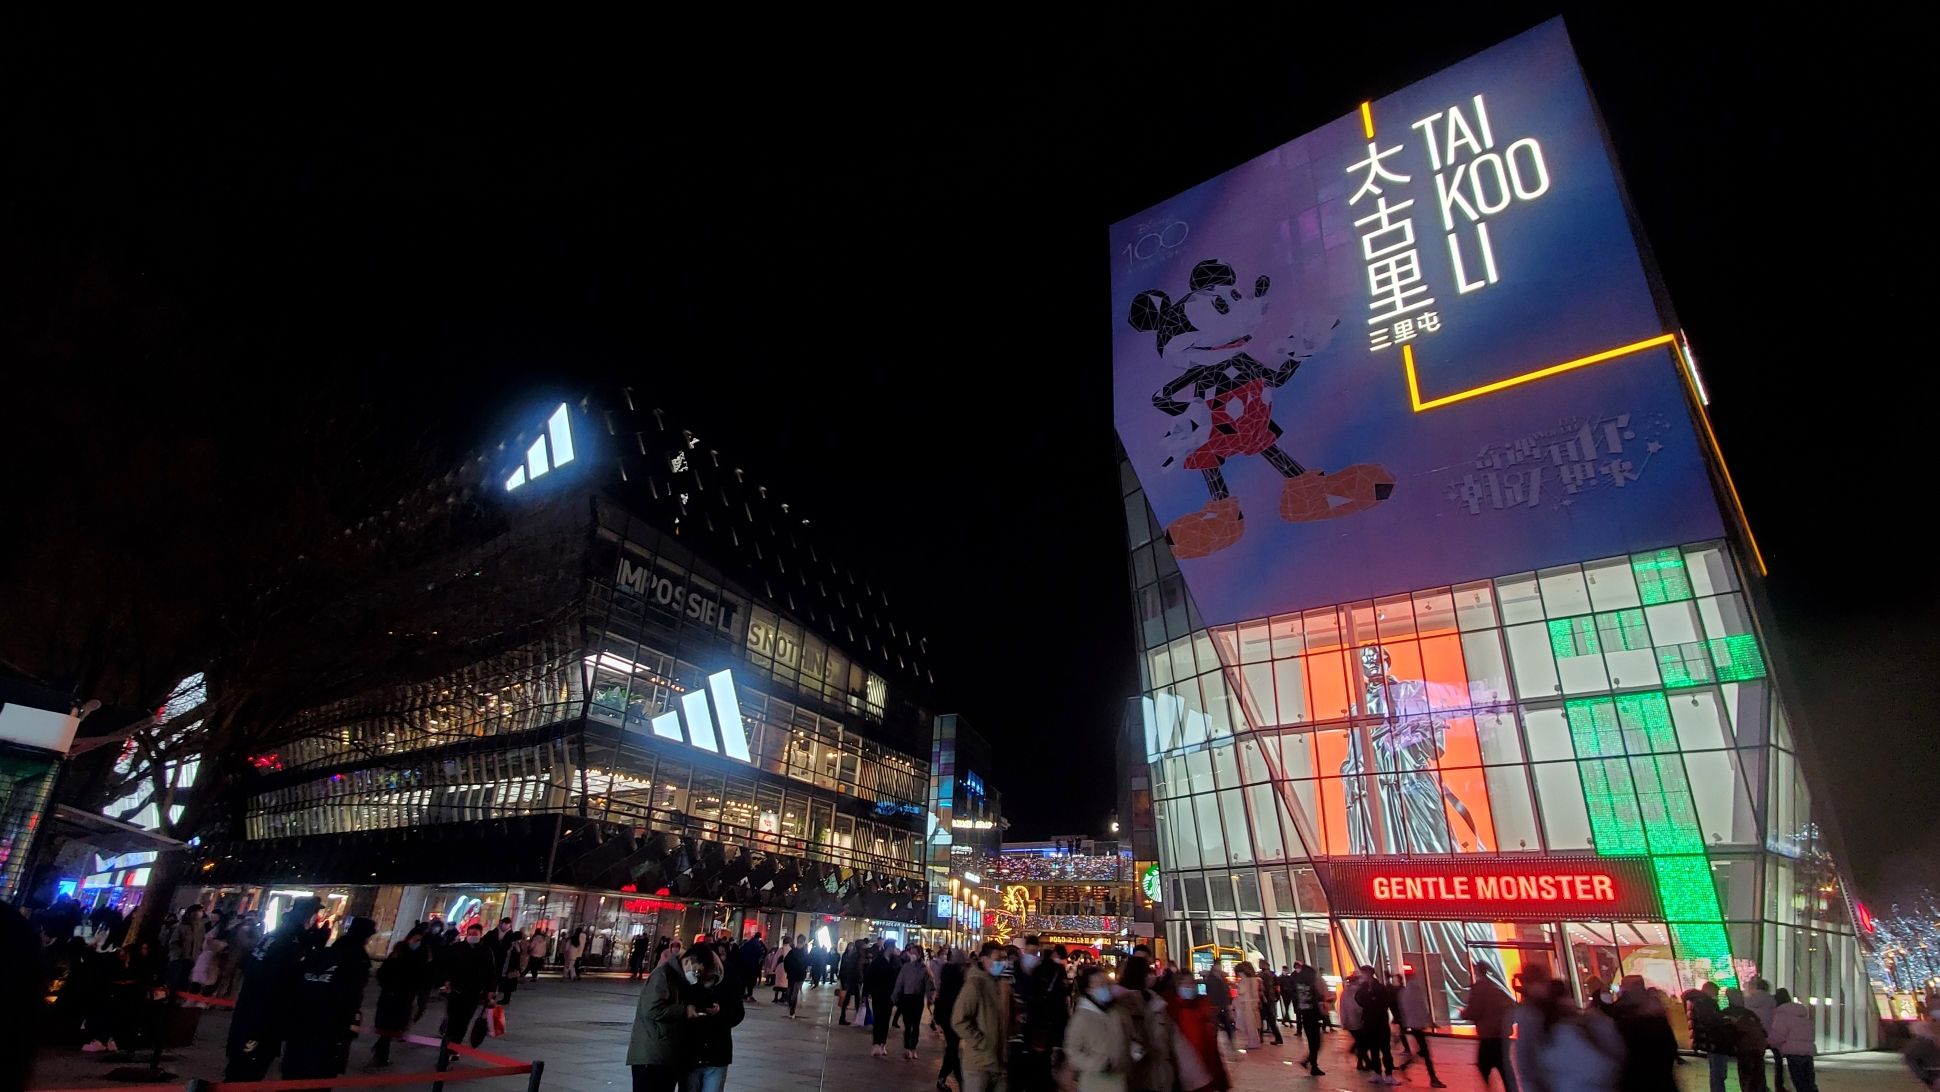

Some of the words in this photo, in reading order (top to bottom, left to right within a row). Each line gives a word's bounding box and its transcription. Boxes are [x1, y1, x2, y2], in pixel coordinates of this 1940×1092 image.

[1411, 94, 1494, 170] TAI
[1435, 137, 1549, 231] KOO
[1121, 221, 1189, 265] 100
[1346, 142, 1435, 325] 太古里
[1447, 222, 1499, 294] LI
[1369, 312, 1441, 351] 三里屯
[1373, 876, 1471, 900] GENTLE
[1474, 875, 1615, 900] MONSTER
